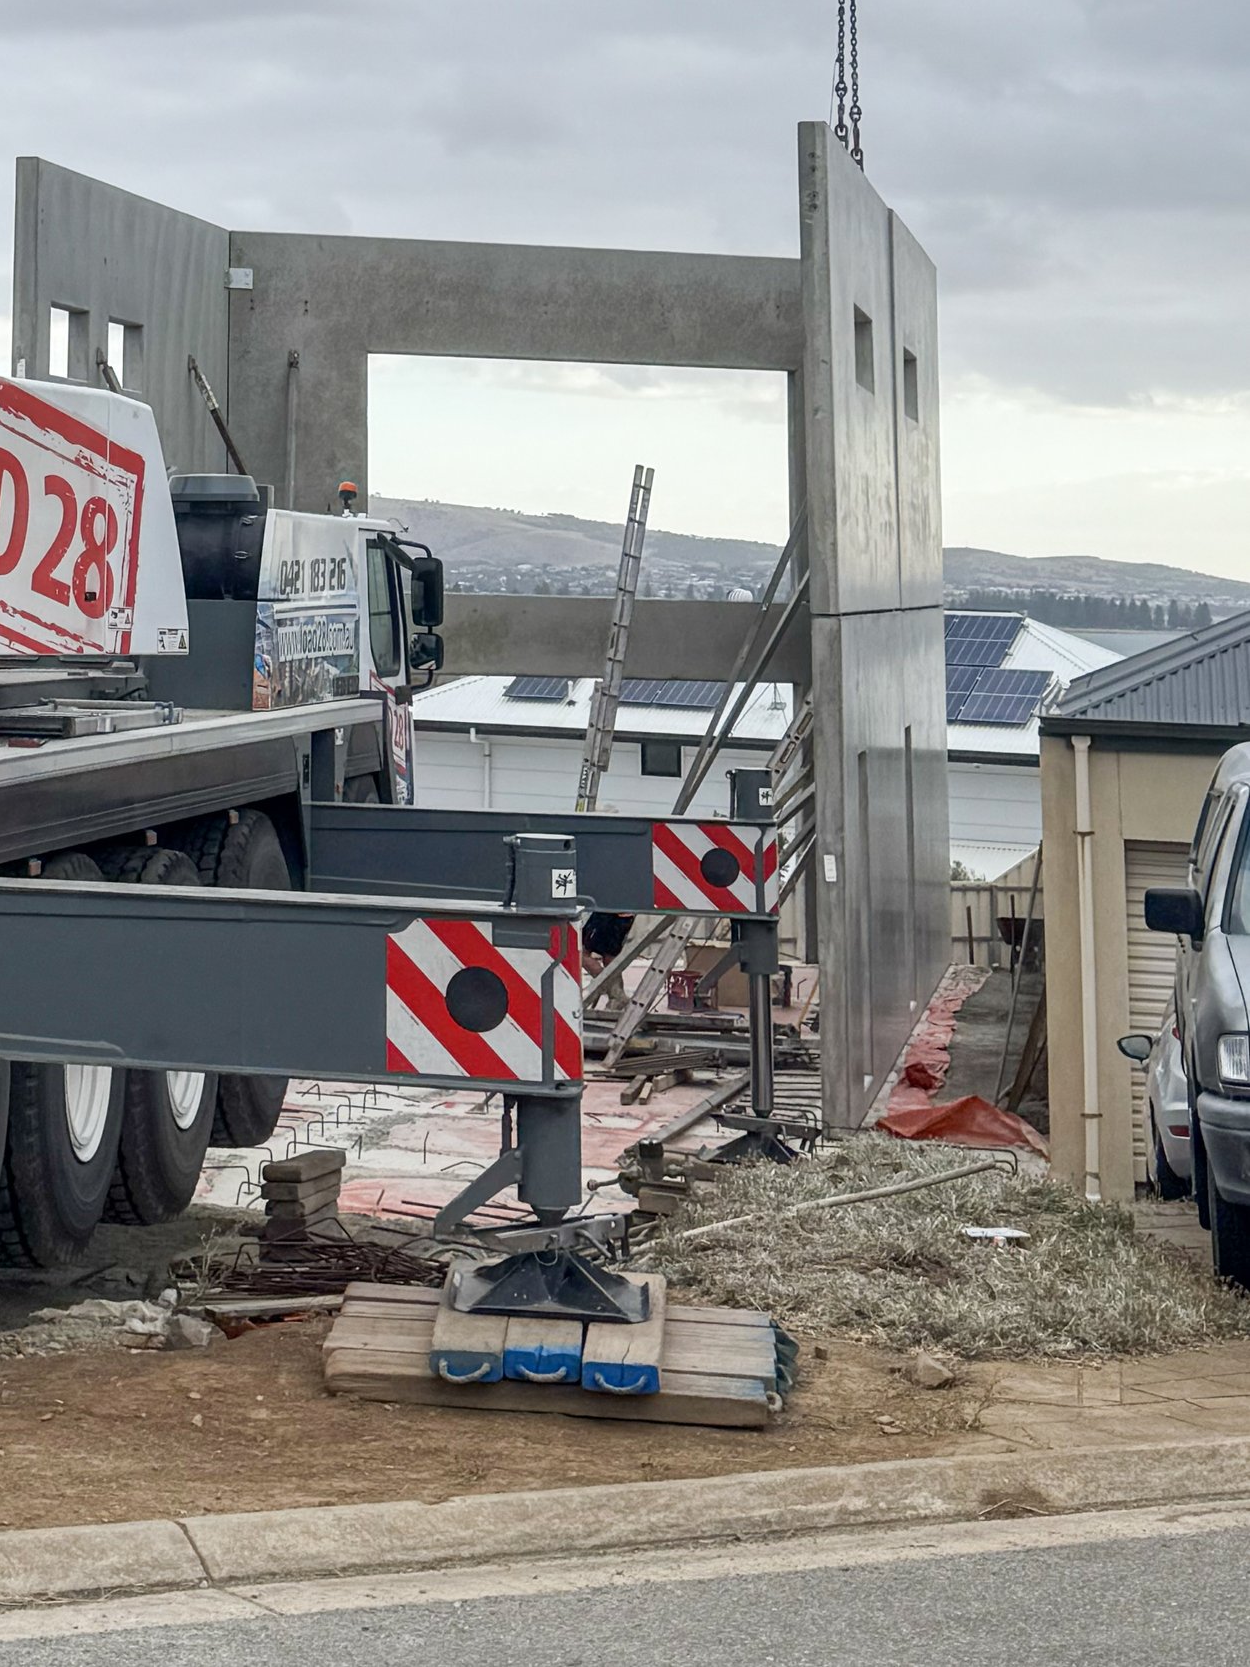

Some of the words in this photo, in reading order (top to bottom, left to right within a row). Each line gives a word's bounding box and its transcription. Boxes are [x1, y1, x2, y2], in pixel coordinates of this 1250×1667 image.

[30, 474, 119, 620] 28
[279, 559, 305, 596] 0421
[310, 558, 326, 593] 183
[328, 557, 347, 592] 216
